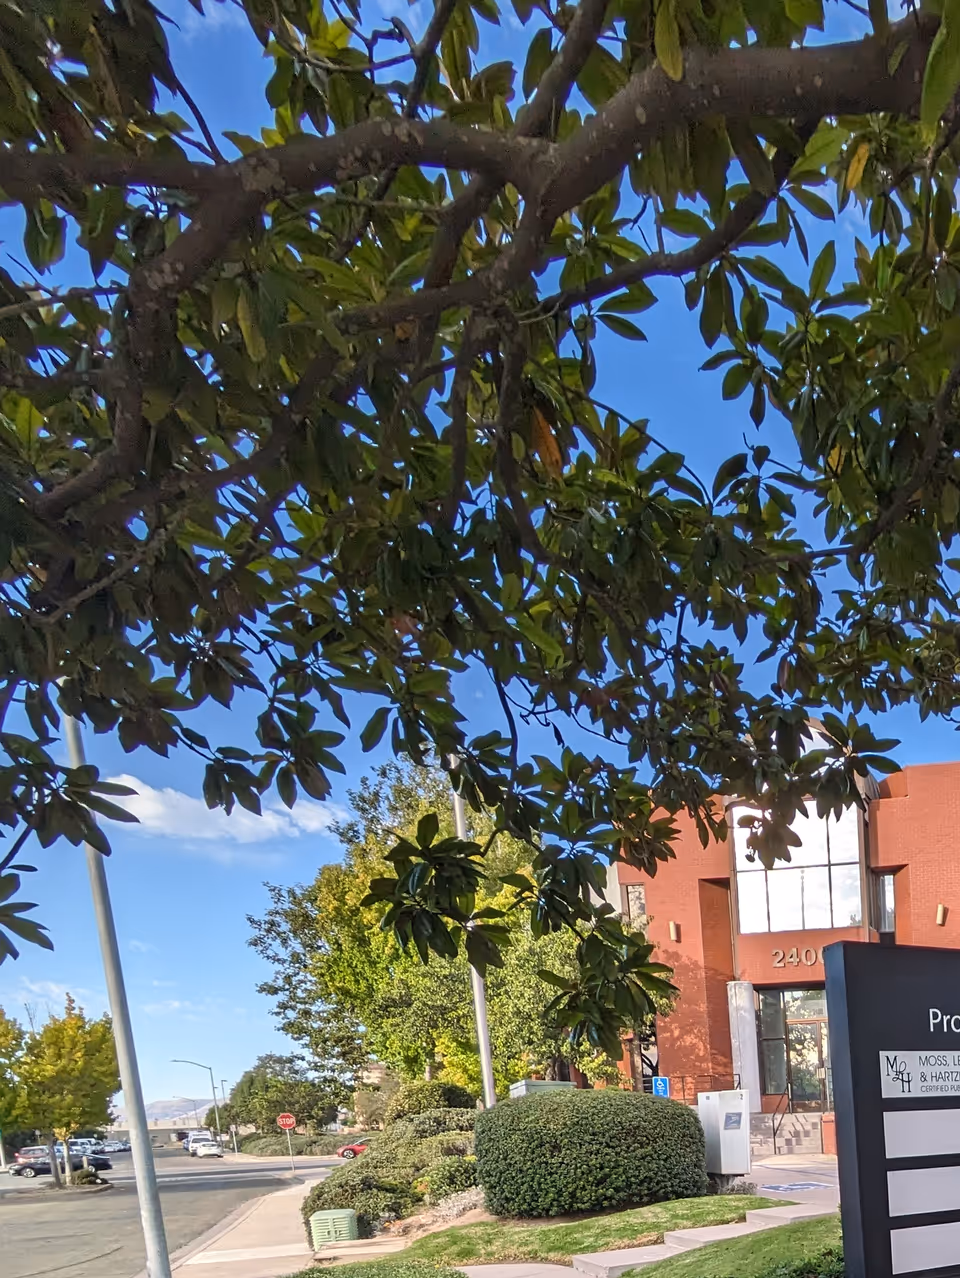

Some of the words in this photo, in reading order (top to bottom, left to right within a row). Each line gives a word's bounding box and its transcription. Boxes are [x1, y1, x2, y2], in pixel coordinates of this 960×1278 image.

[918, 1055, 950, 1067] MOSS,
[919, 1071, 928, 1082] &
[920, 1084, 949, 1093] CERTIFIED
